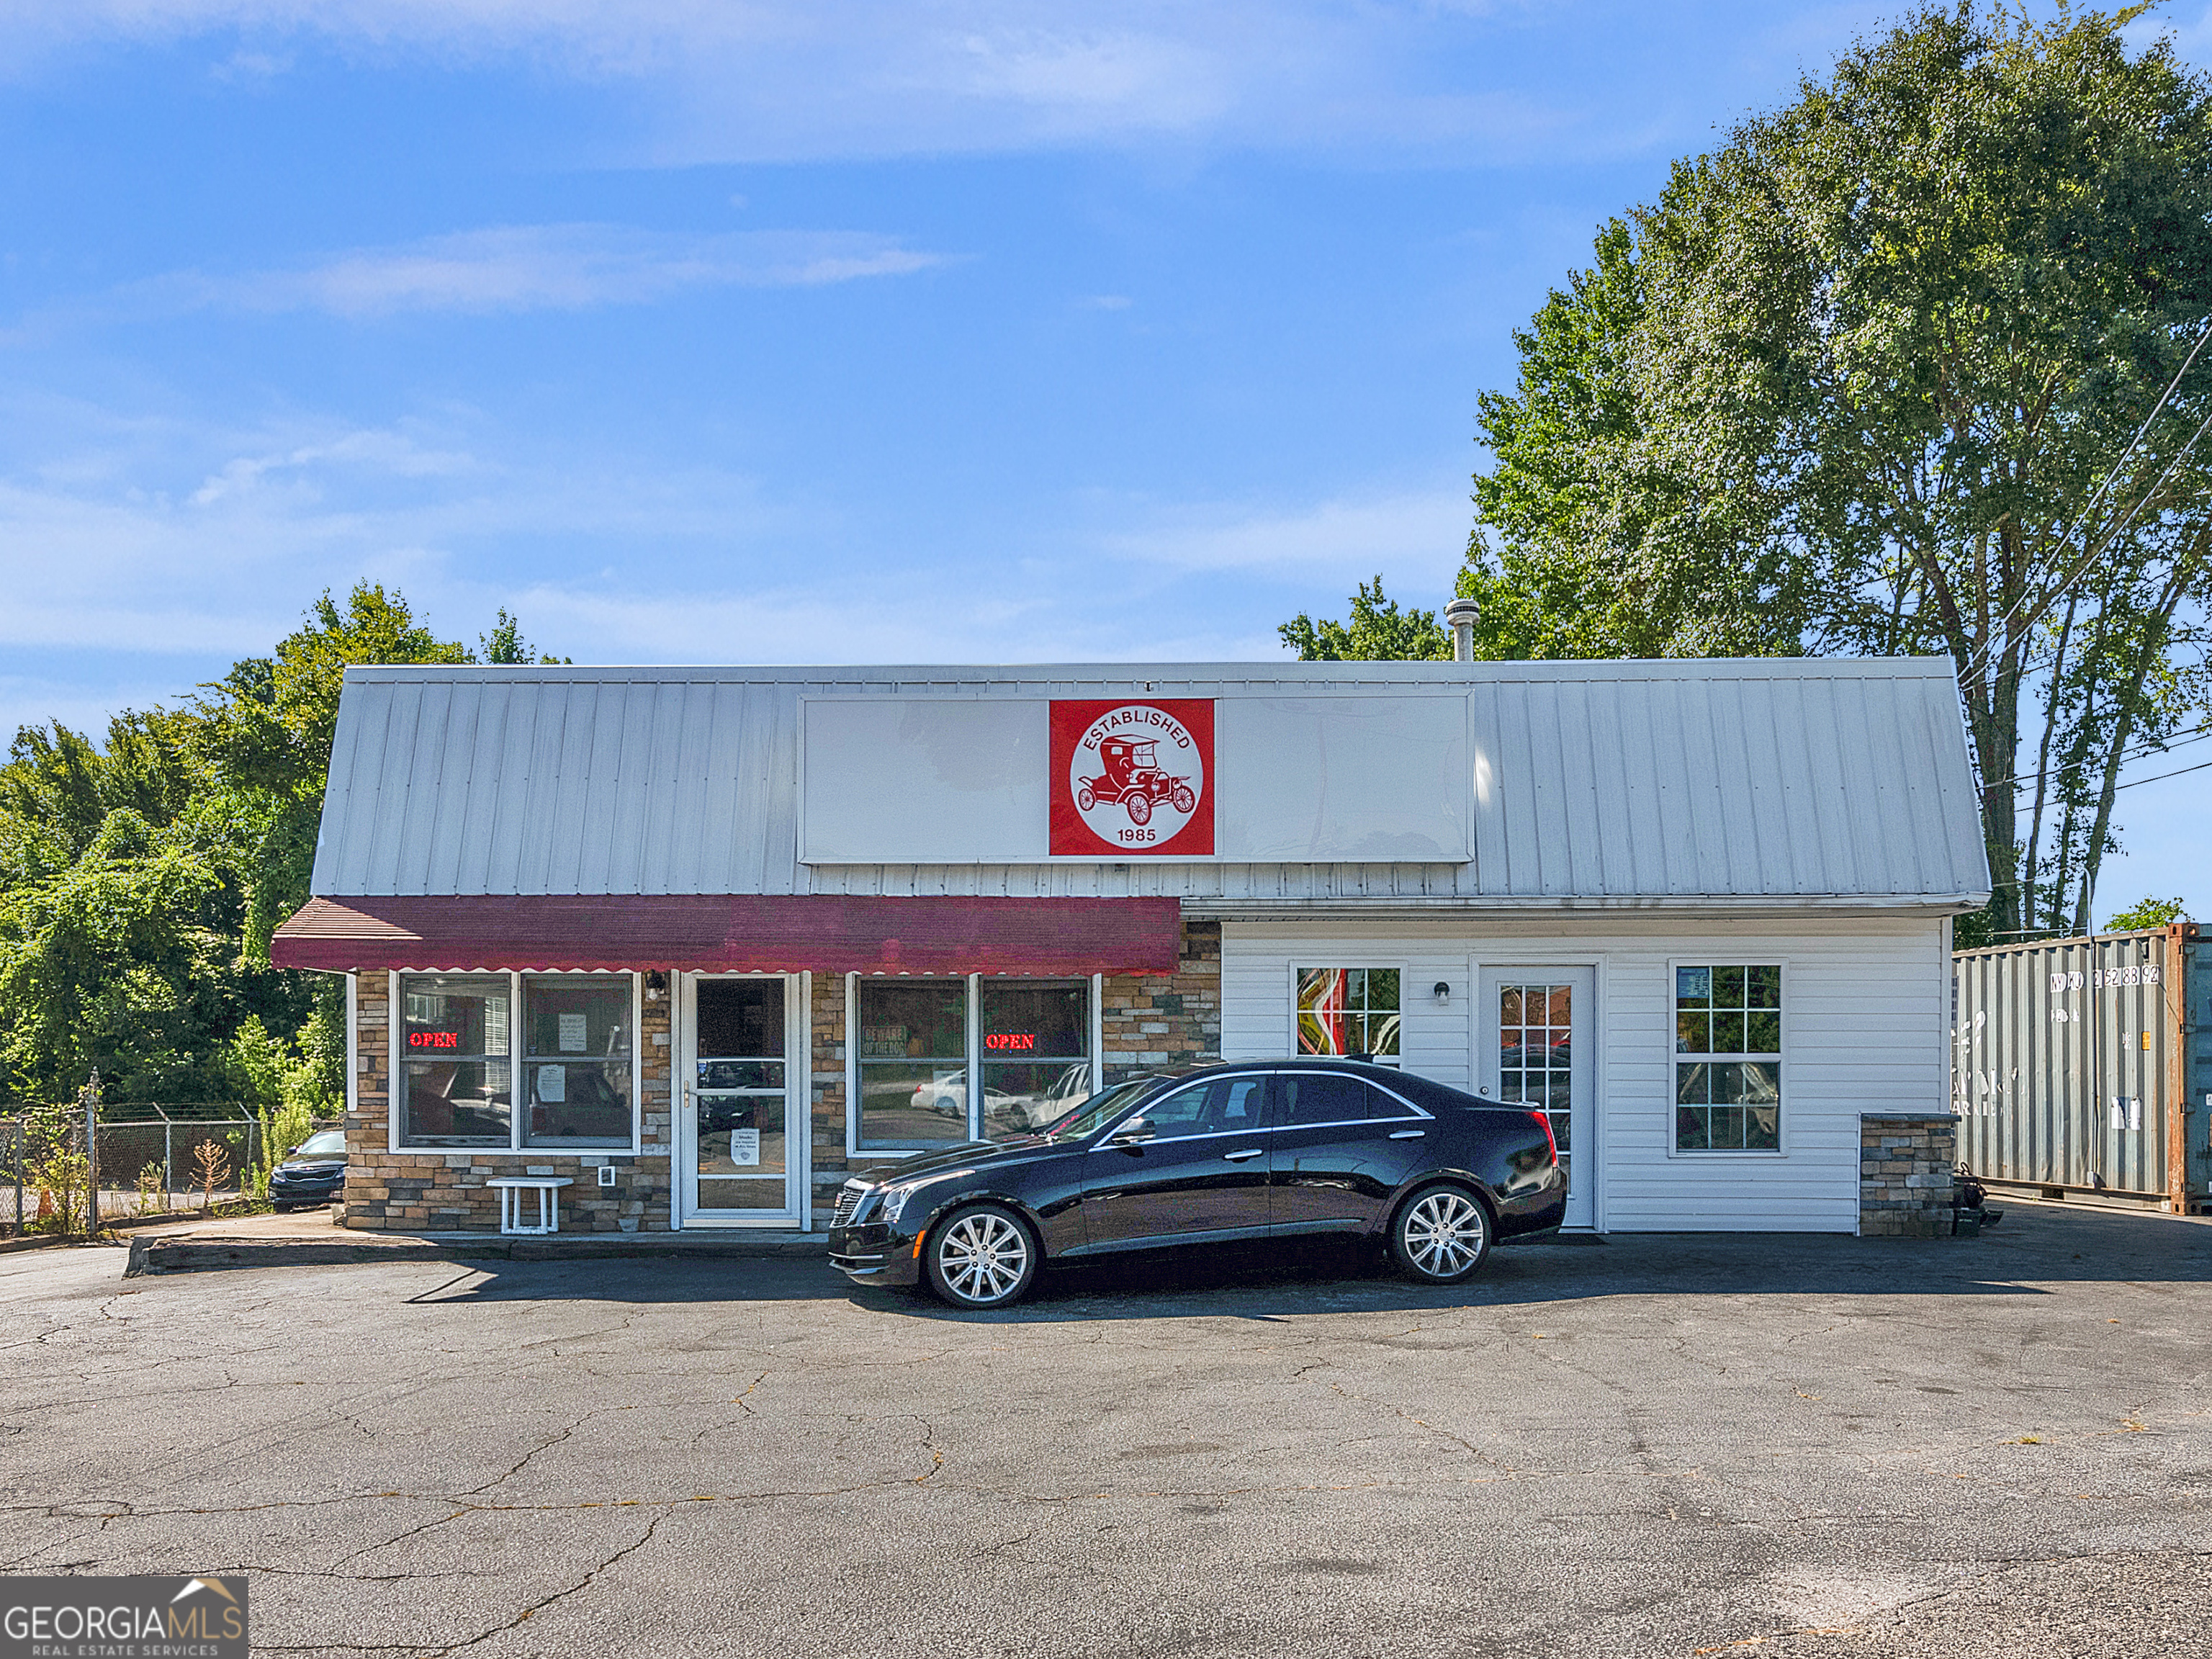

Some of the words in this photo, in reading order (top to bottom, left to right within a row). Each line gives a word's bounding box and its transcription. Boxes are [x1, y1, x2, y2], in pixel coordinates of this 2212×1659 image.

[1083, 710, 1190, 751] ESTABLISHED
[1118, 829, 1156, 842] 1985
[410, 1032, 458, 1048] OPEN
[875, 1041, 889, 1054] THE
[986, 1033, 1035, 1050] OPEN
